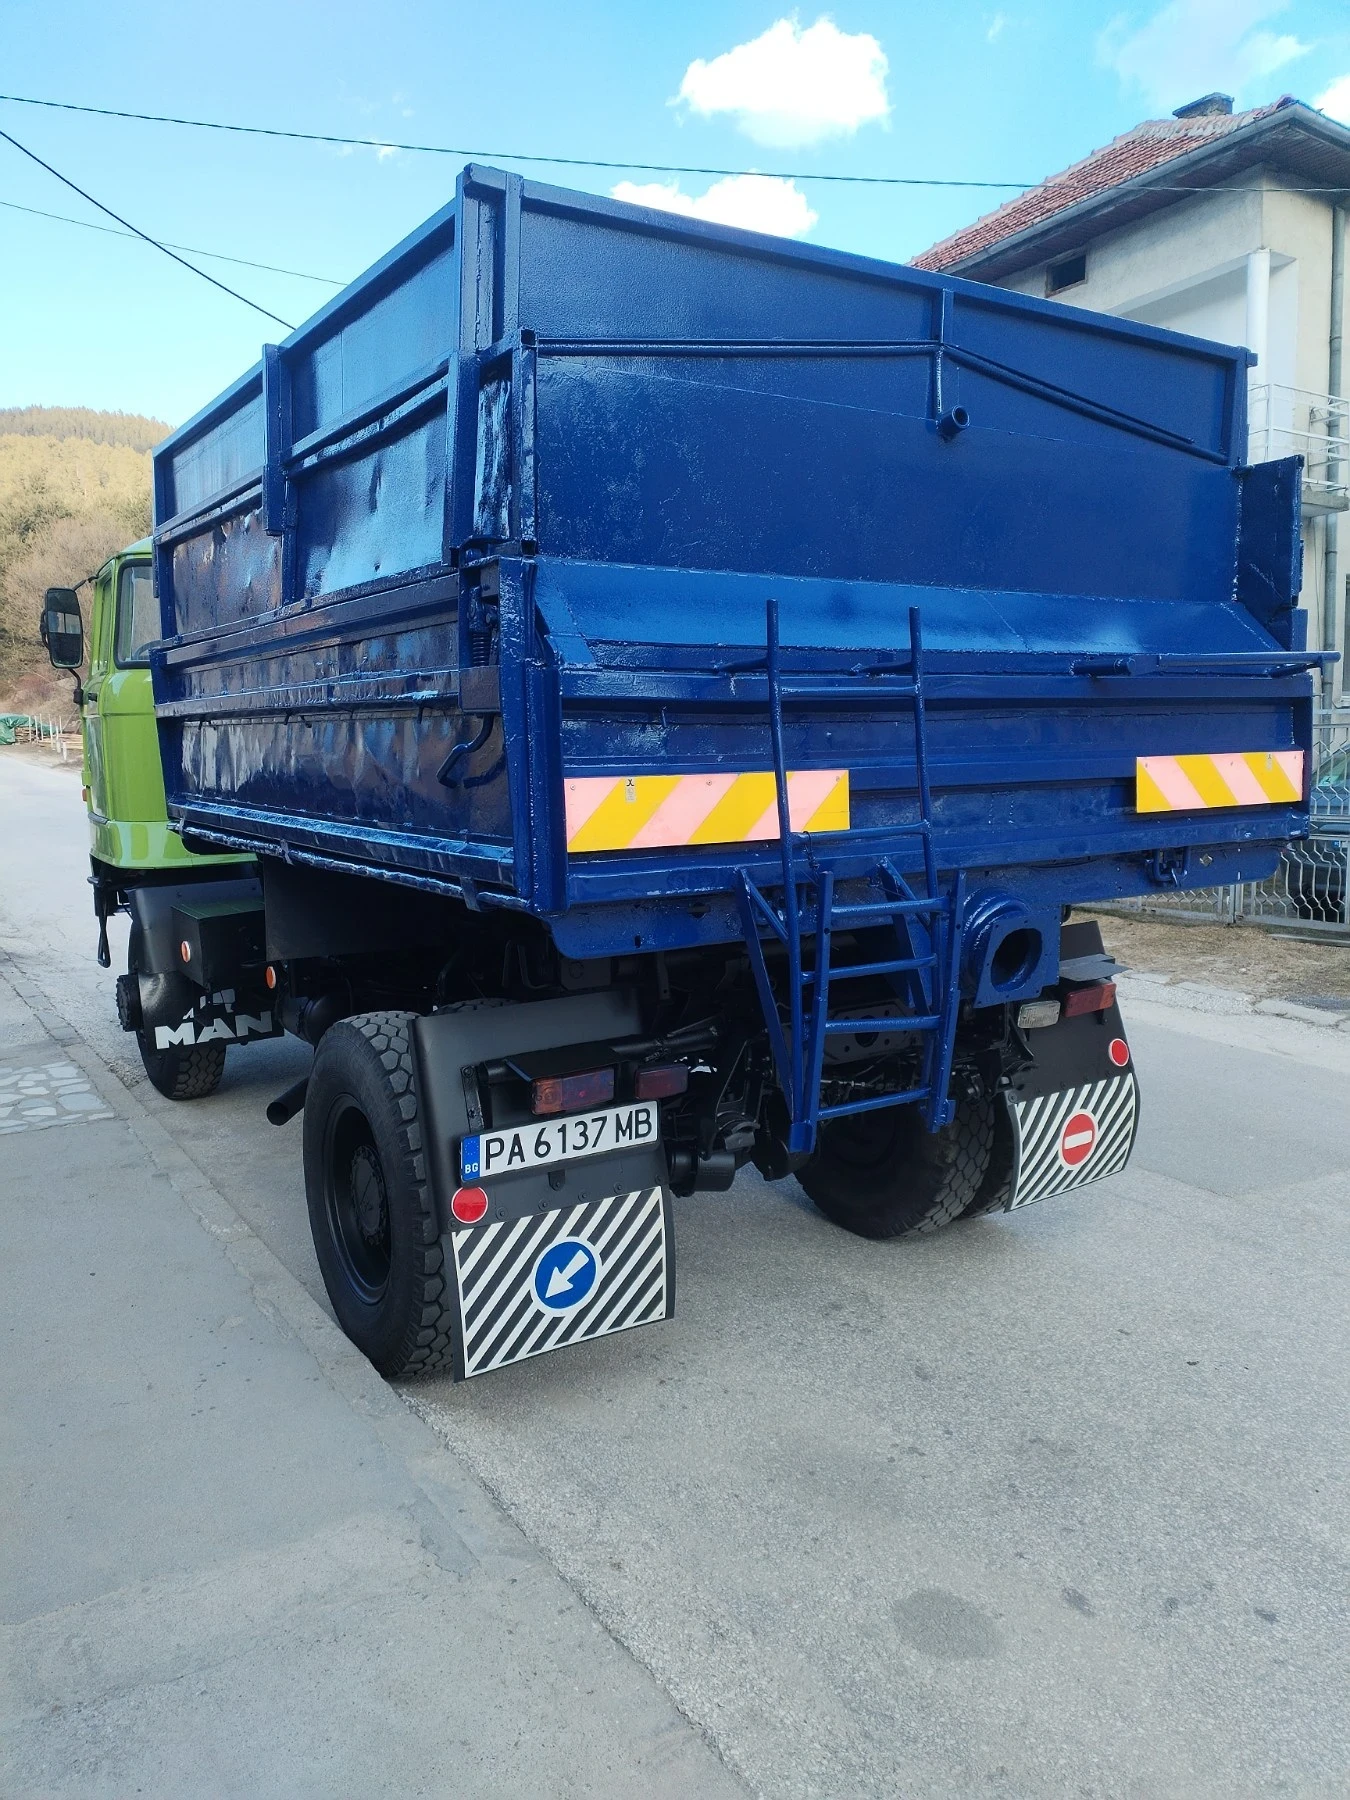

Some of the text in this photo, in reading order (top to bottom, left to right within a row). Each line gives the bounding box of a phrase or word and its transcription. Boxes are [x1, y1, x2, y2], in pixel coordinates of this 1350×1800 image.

[155, 1011, 272, 1050] MAN
[485, 1108, 652, 1170] PA 6137 MB
[464, 1162, 479, 1174] BG
